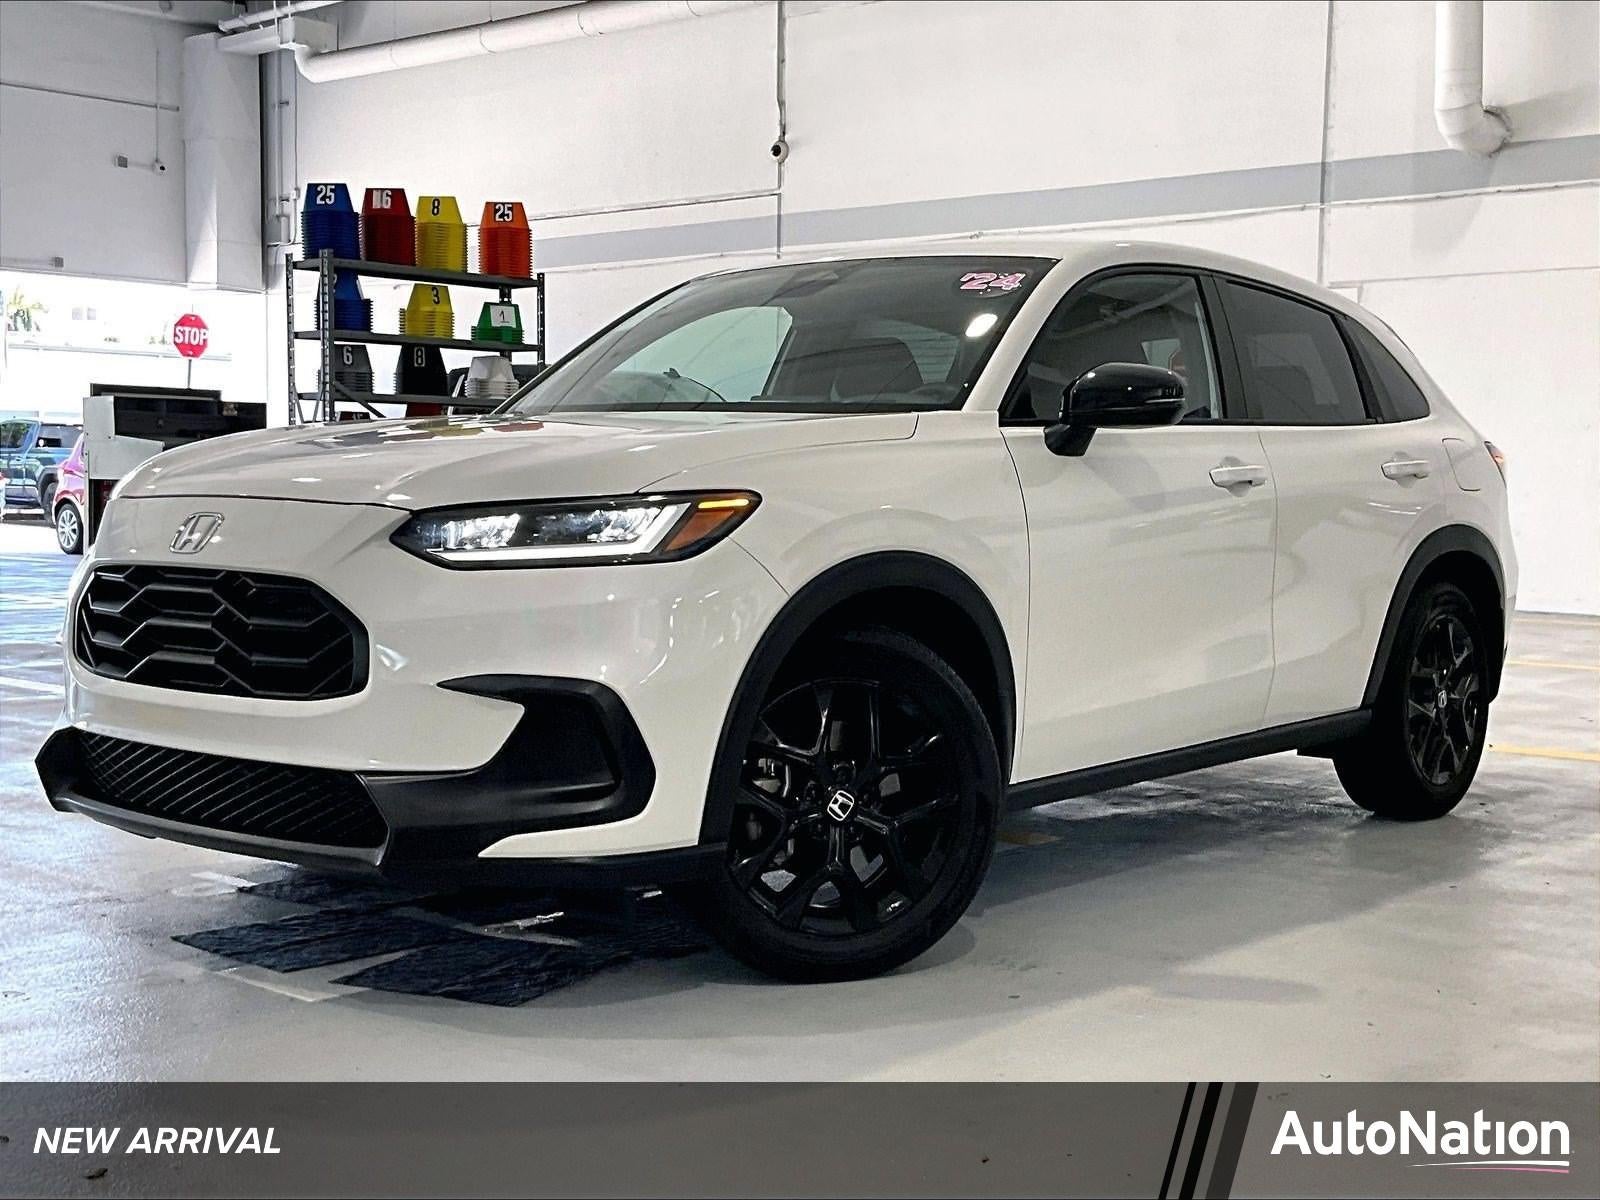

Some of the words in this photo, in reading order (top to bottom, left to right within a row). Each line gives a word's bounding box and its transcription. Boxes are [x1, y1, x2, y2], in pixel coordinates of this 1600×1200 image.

[316, 185, 335, 205] 25
[431, 198, 441, 216] 8
[494, 203, 513, 222] 25
[432, 286, 441, 305] 3
[174, 325, 208, 346] STOP
[342, 346, 353, 365] 6
[414, 347, 424, 366] 8
